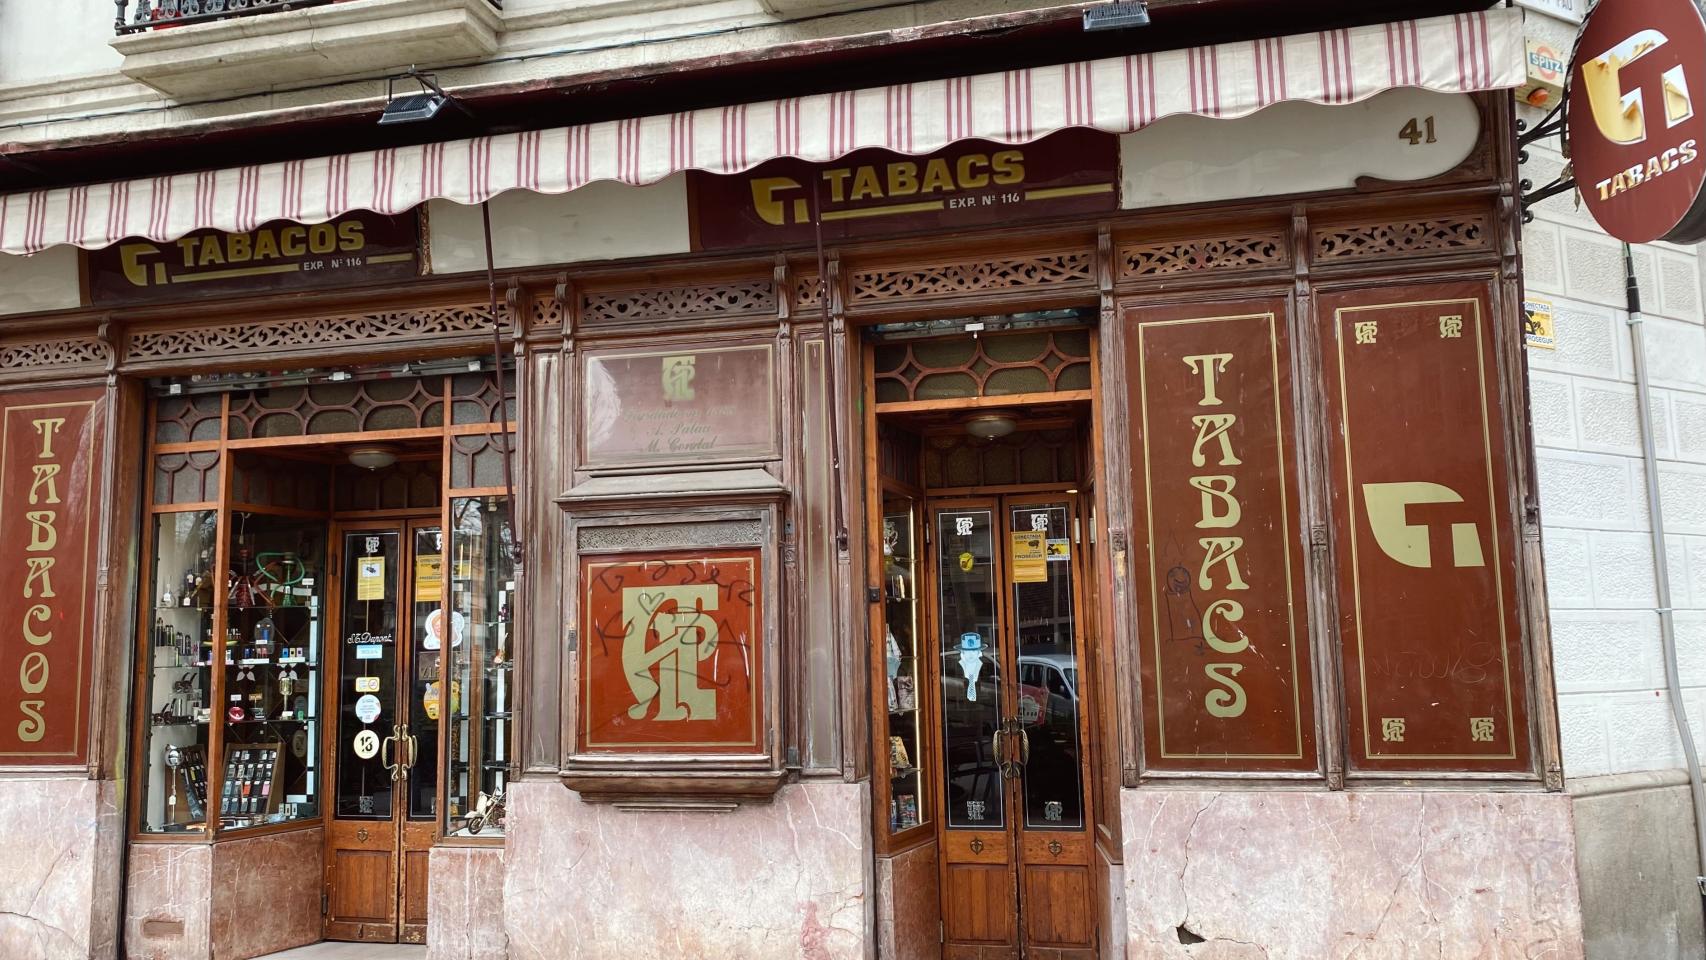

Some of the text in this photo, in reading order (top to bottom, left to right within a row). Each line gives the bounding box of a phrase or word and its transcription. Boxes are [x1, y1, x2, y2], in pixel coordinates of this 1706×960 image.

[1531, 54, 1564, 72] SPITZ
[1399, 115, 1437, 146] 41
[823, 150, 1026, 203] TABACS
[1595, 139, 1698, 201] TABACS
[949, 197, 976, 209] EXP.
[1001, 193, 1020, 204] 116
[177, 220, 366, 268] TABACOS
[303, 258, 325, 271] EXP.
[346, 257, 362, 267] 116
[1183, 353, 1249, 718] TABACS
[17, 417, 66, 743] TABACOS
